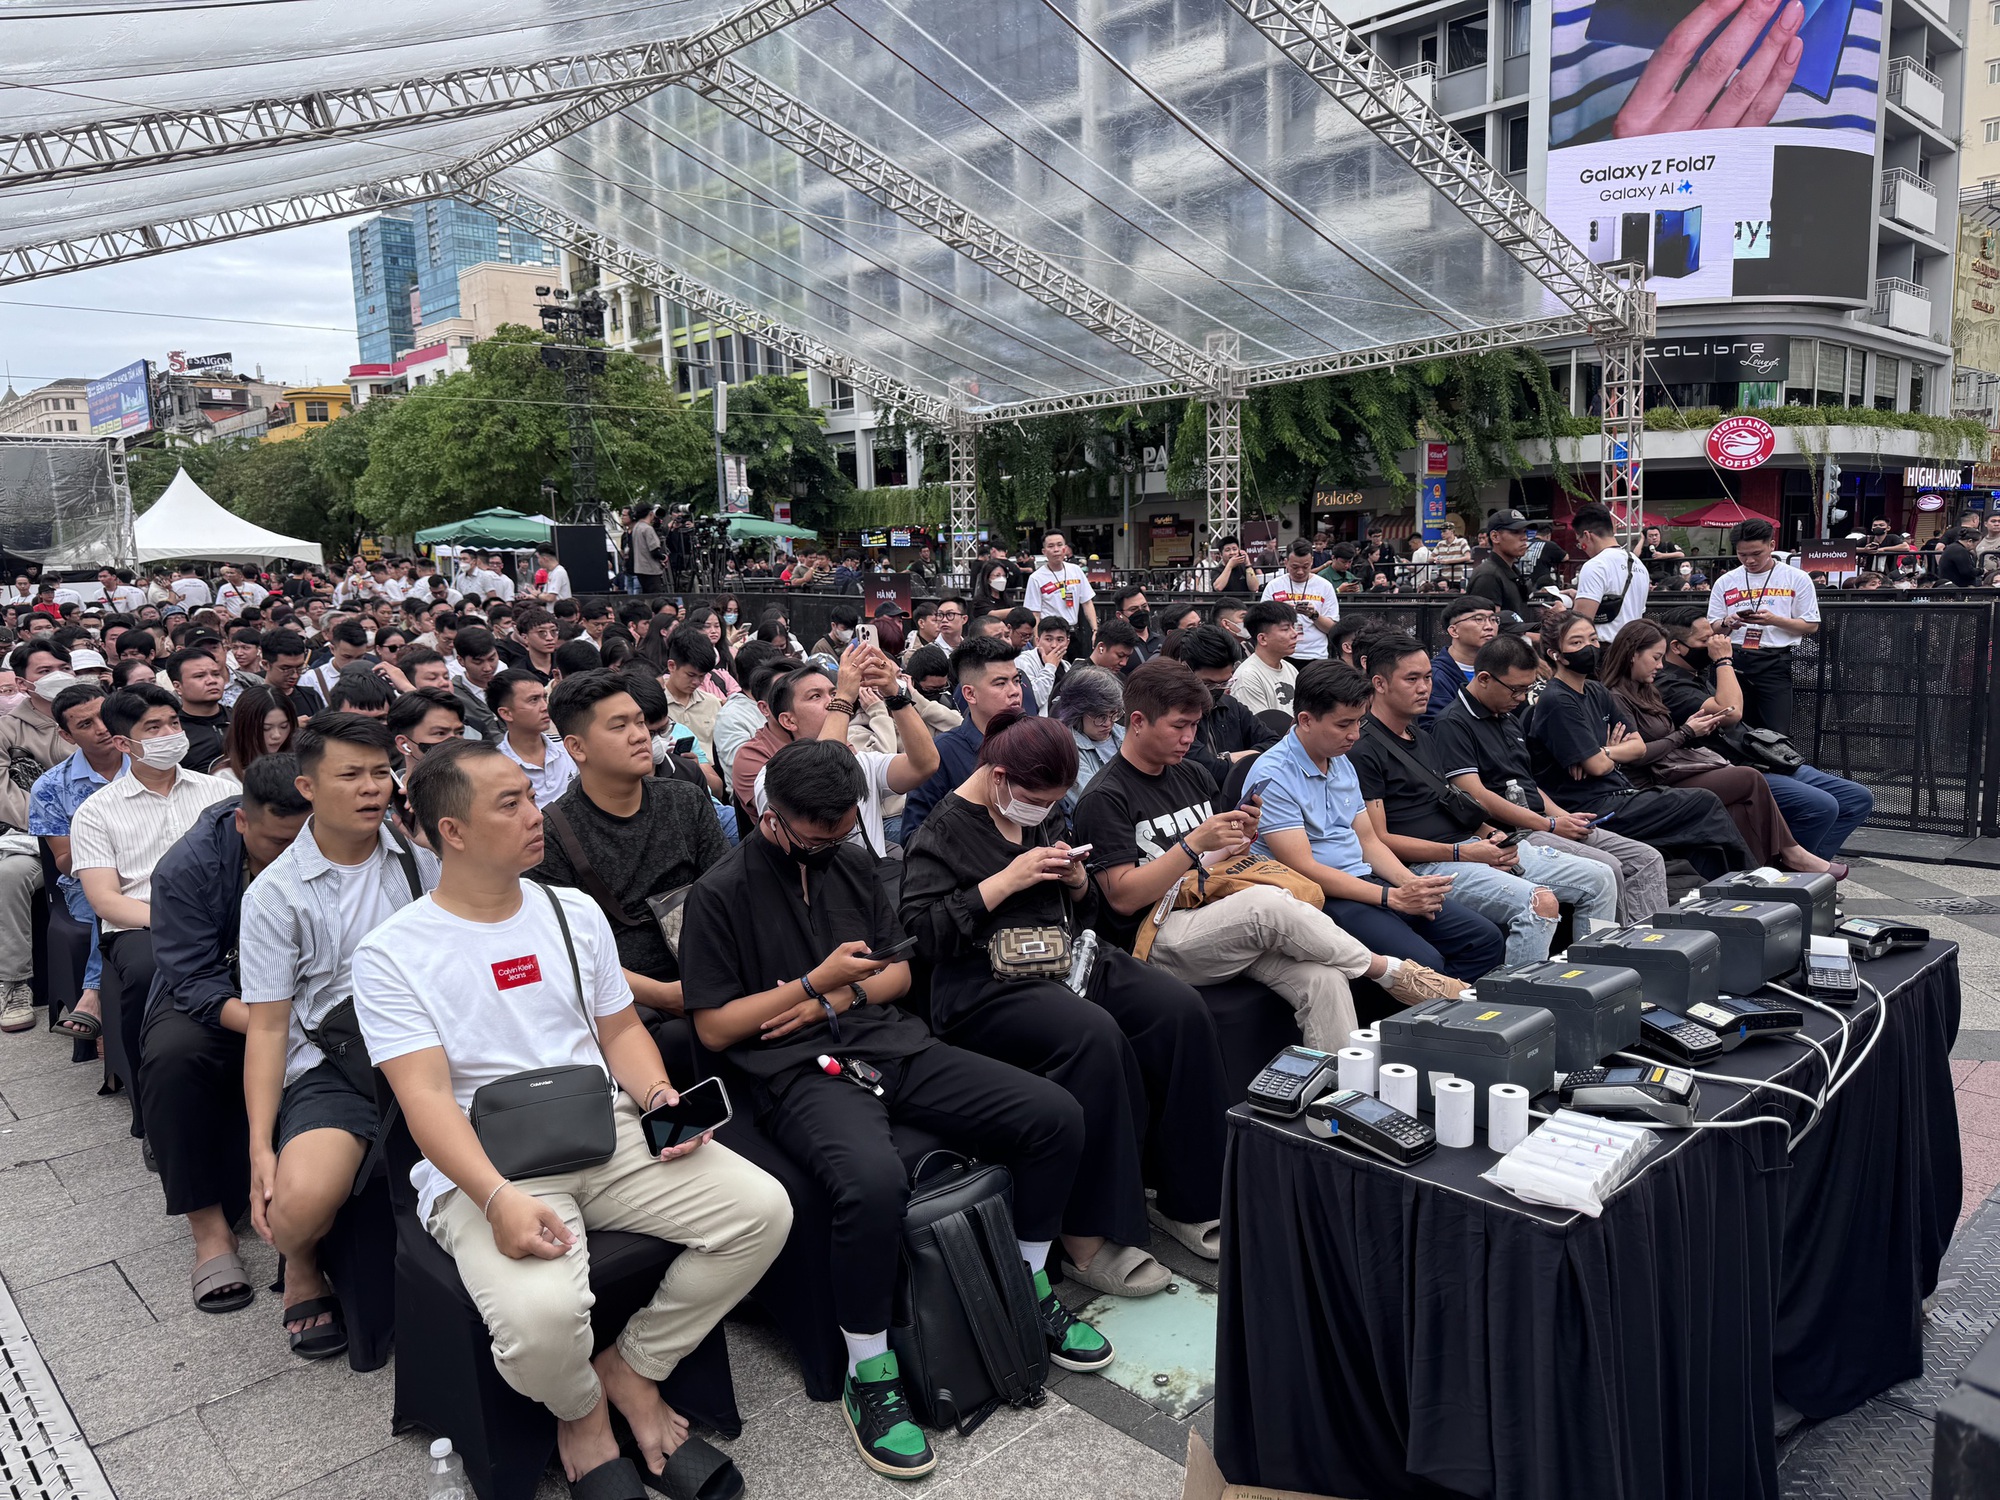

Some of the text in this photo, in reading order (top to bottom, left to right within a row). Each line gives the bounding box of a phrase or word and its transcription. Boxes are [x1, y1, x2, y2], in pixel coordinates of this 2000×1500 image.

[1580, 155, 1716, 184] Galaxy Z Fold7
[1600, 182, 1674, 202] Galaxy AI
[1711, 419, 1773, 442] HIGHLANDS
[1718, 453, 1765, 468] COFFEE
[1907, 467, 1962, 488] HIGHLANDS
[1316, 490, 1363, 506] Palace
[1808, 551, 1848, 559] HẢI PHÒNG
[876, 589, 897, 600] HÀ NỘI
[1767, 589, 1792, 597] NAM
[498, 963, 535, 977] Calvin Klein
[507, 971, 527, 982] Jeans
